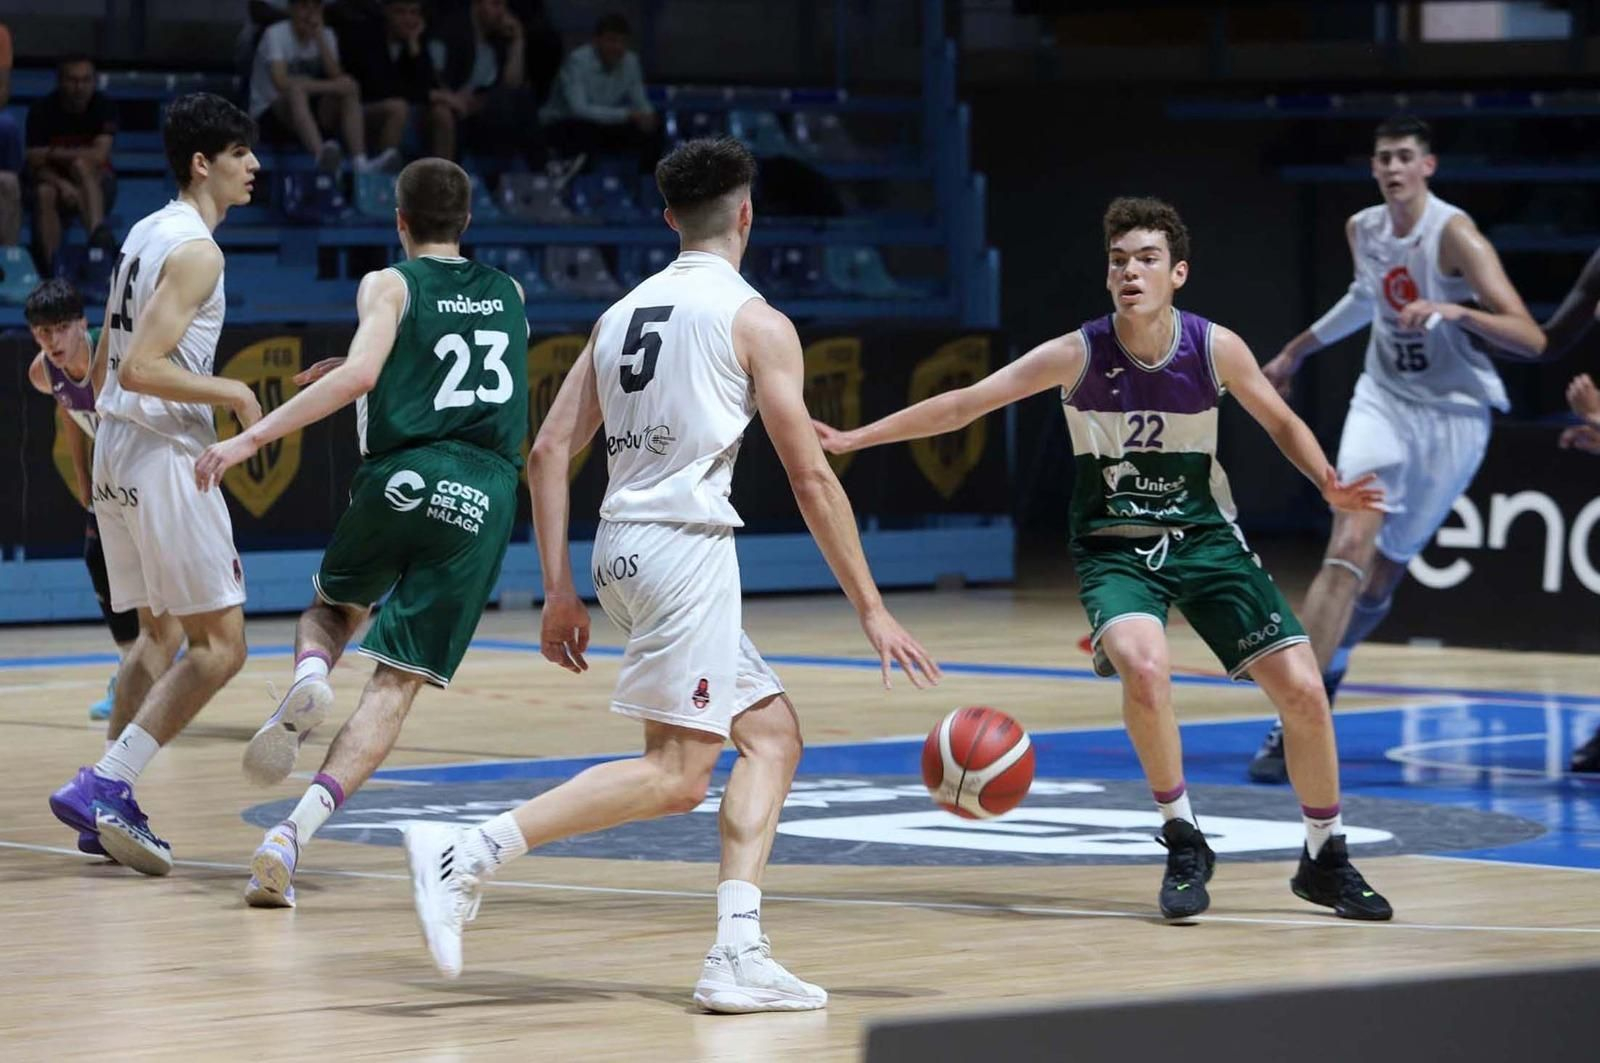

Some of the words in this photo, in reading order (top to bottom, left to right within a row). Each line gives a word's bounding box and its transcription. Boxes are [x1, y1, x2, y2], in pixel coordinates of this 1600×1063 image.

[437, 294, 504, 316] málaga
[620, 305, 675, 394] 5
[433, 329, 514, 411] 23
[1123, 414, 1165, 448] 22
[430, 493, 459, 511] DEL
[460, 501, 485, 524] SOL
[436, 480, 490, 512] COSTA
[426, 506, 480, 536] MÁLAGA
